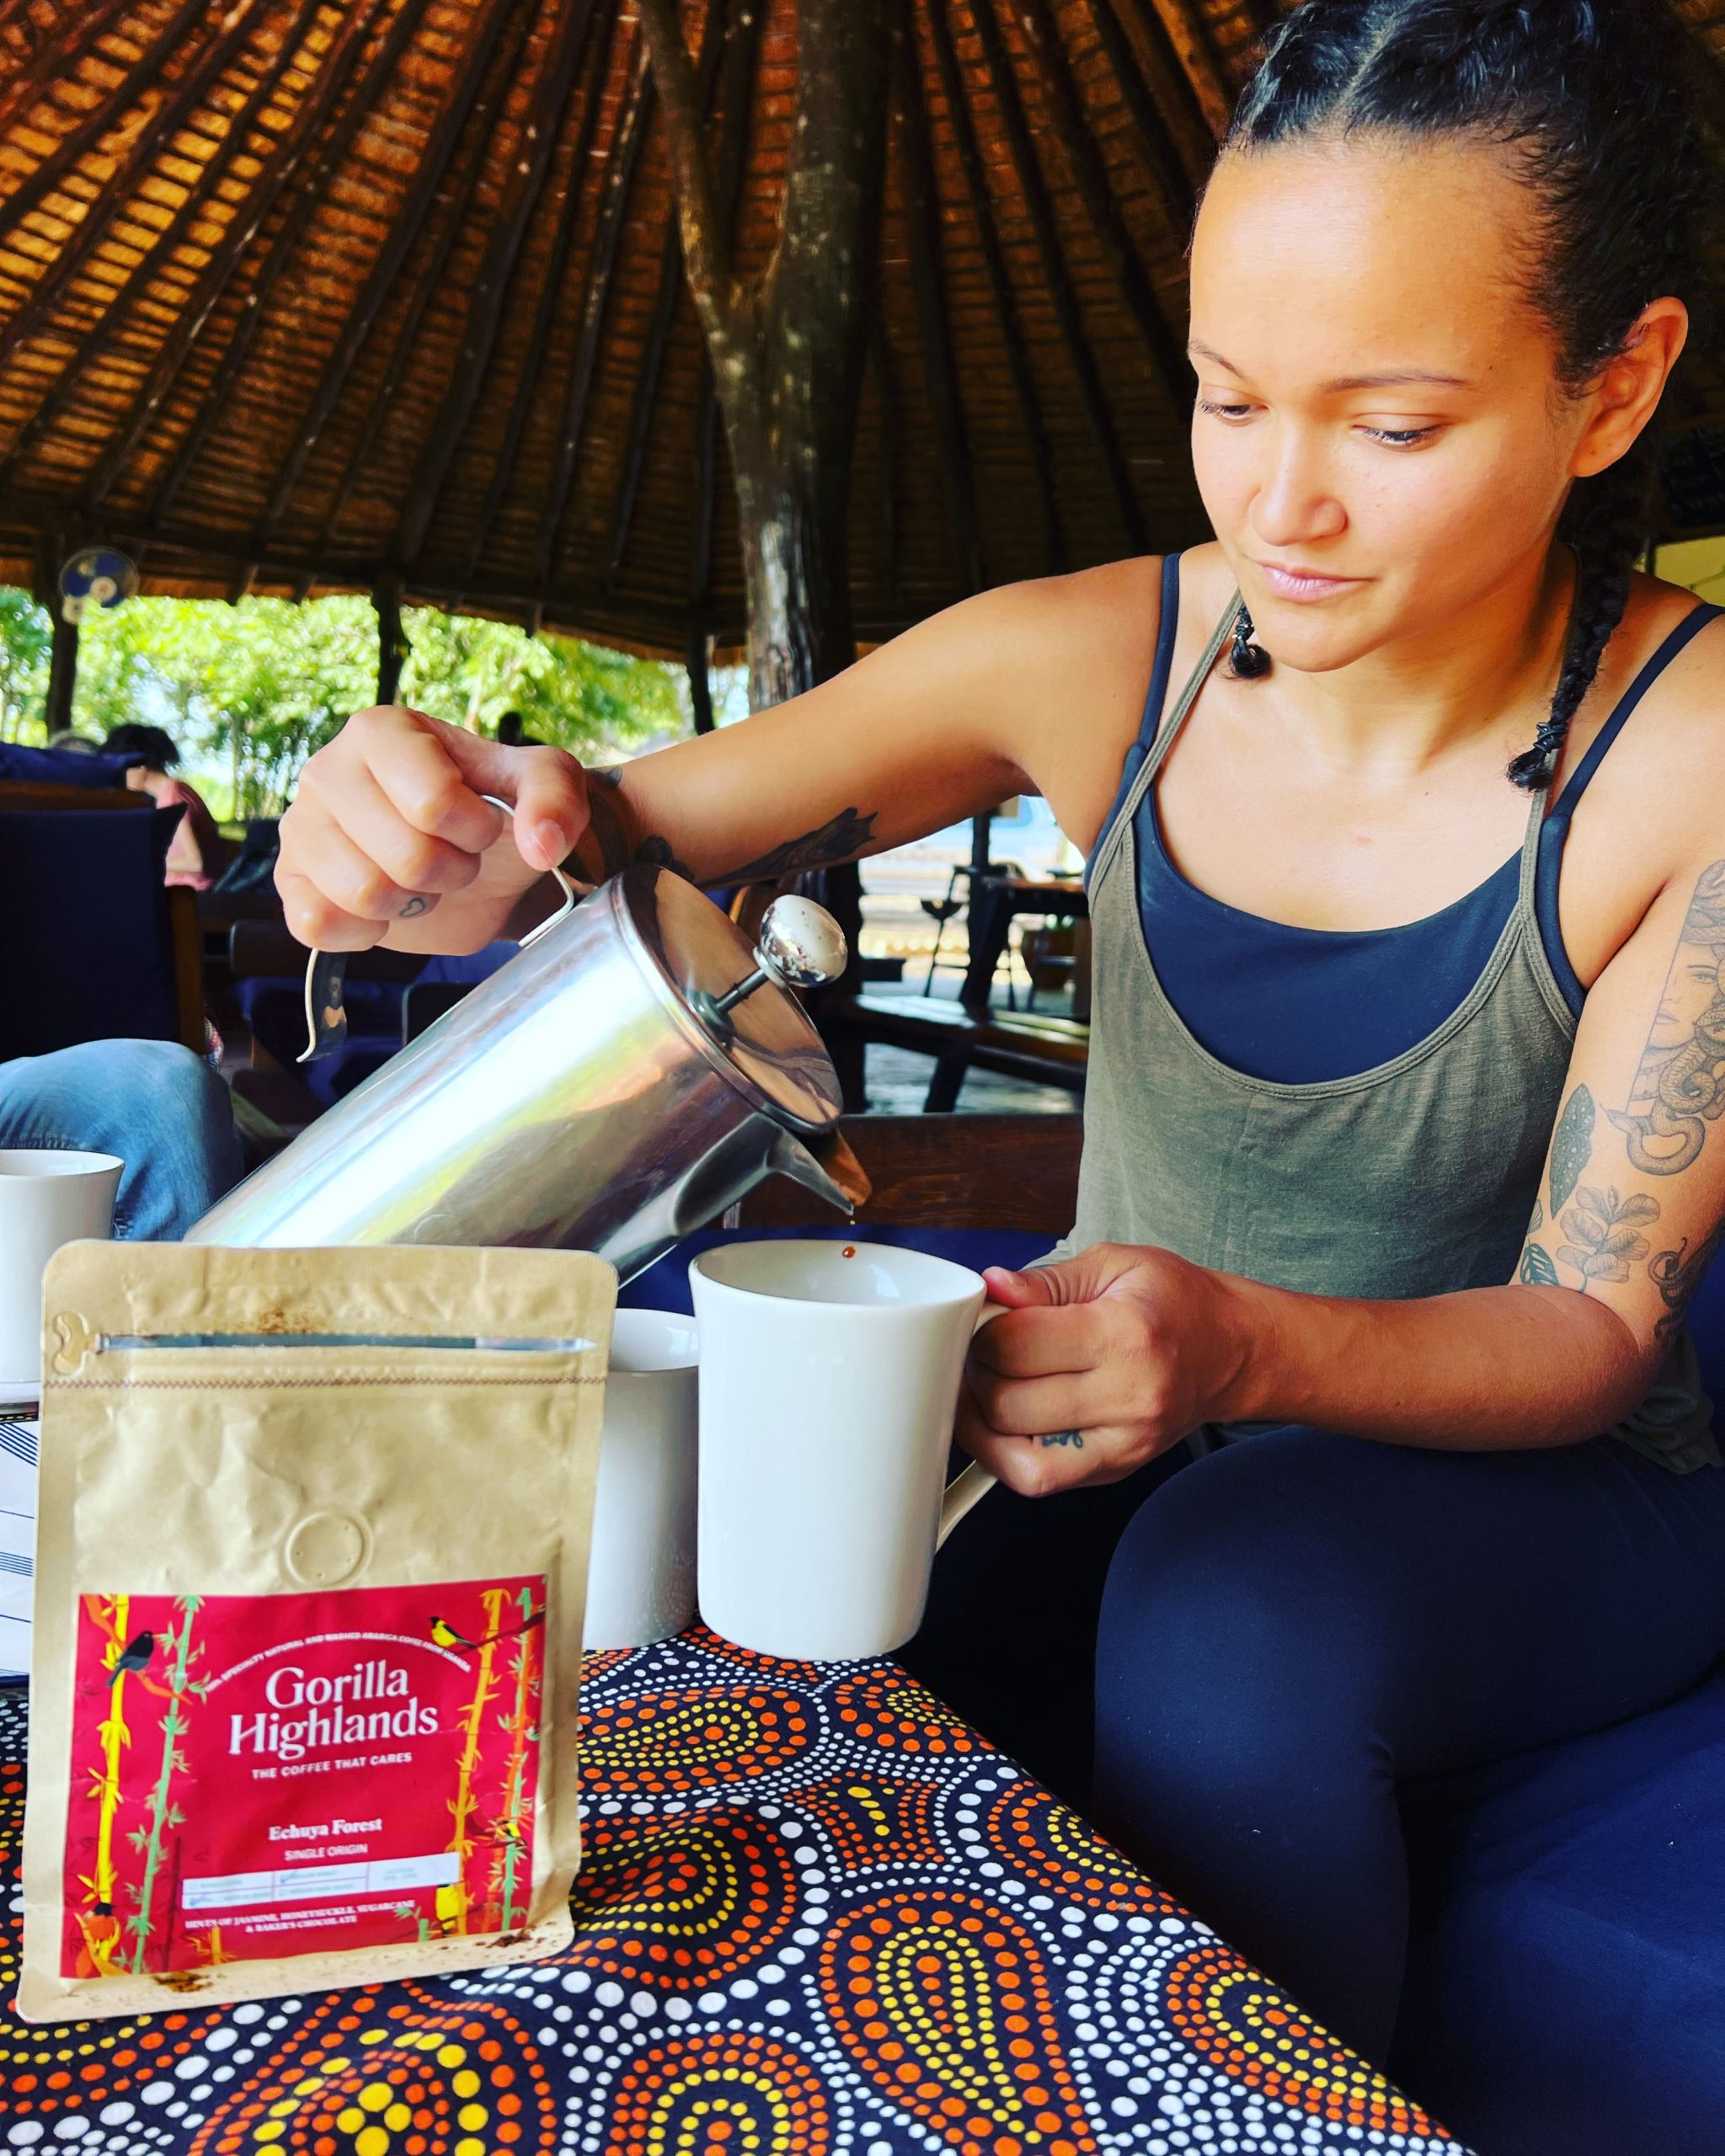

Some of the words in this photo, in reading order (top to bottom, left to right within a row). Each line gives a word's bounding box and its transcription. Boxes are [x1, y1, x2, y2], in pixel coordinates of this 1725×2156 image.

[362, 1632, 398, 1641] ARABICA
[423, 1641, 444, 1655] FROM
[443, 1649, 471, 1673] UGANDA
[265, 1659, 409, 1709] Gorilla
[228, 1696, 438, 1761] Highlands
[253, 1768, 276, 1780] THE
[280, 1760, 331, 1777] COFFEE
[334, 1757, 366, 1769] THAT
[370, 1752, 412, 1765] CARES
[269, 1824, 328, 1840] Echuya
[332, 1818, 382, 1834] Forest
[284, 1847, 325, 1861] SINGLE
[328, 1843, 368, 1857] ORIGIN
[357, 1900, 415, 1913] SUGARCANE
